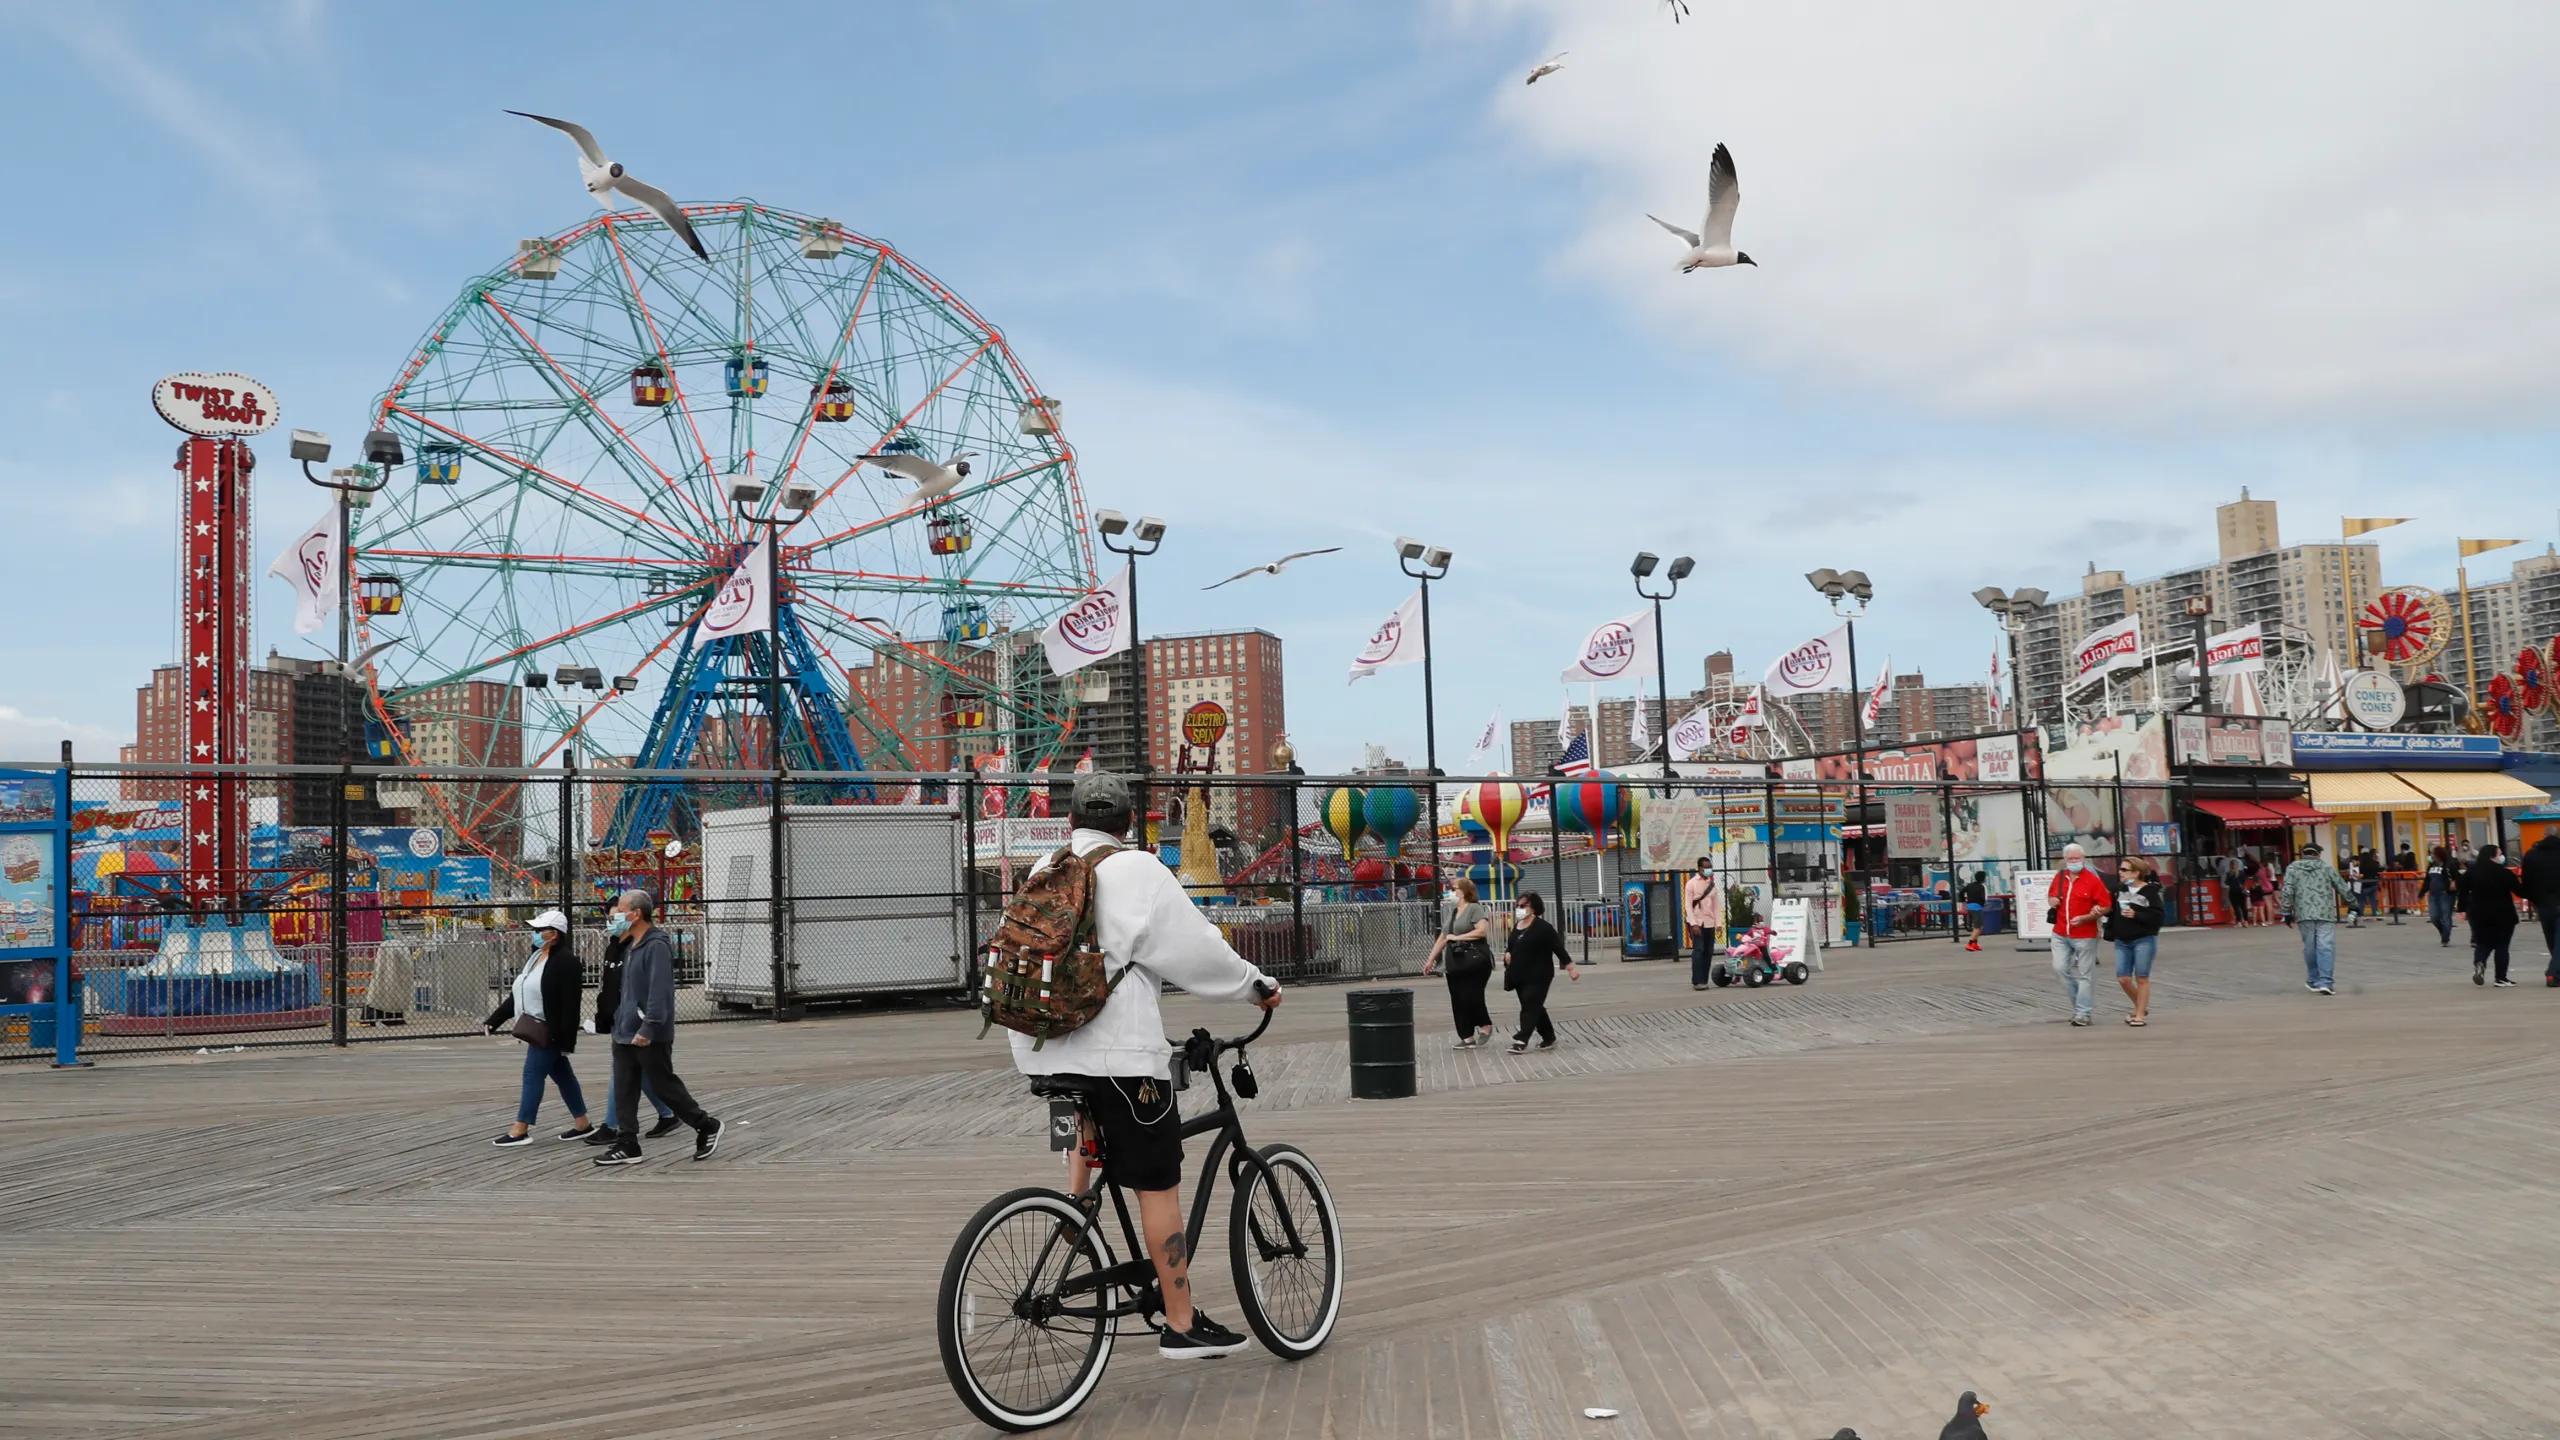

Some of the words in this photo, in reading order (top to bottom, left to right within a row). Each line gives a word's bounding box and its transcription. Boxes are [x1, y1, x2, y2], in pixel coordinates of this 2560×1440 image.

[171, 382, 235, 405] TWIST
[242, 392, 258, 409] &
[202, 402, 266, 426] SHOUT
[2355, 690, 2397, 702] CONEY'S
[2360, 702, 2393, 713] CONES
[1186, 712, 1226, 727] ELECTRO
[1192, 727, 1217, 744] SPIN
[1982, 750, 2014, 762] SNACK
[1989, 762, 2009, 774] BAR
[1894, 804, 1916, 817] THANK
[2142, 833, 2166, 847] OPEN
